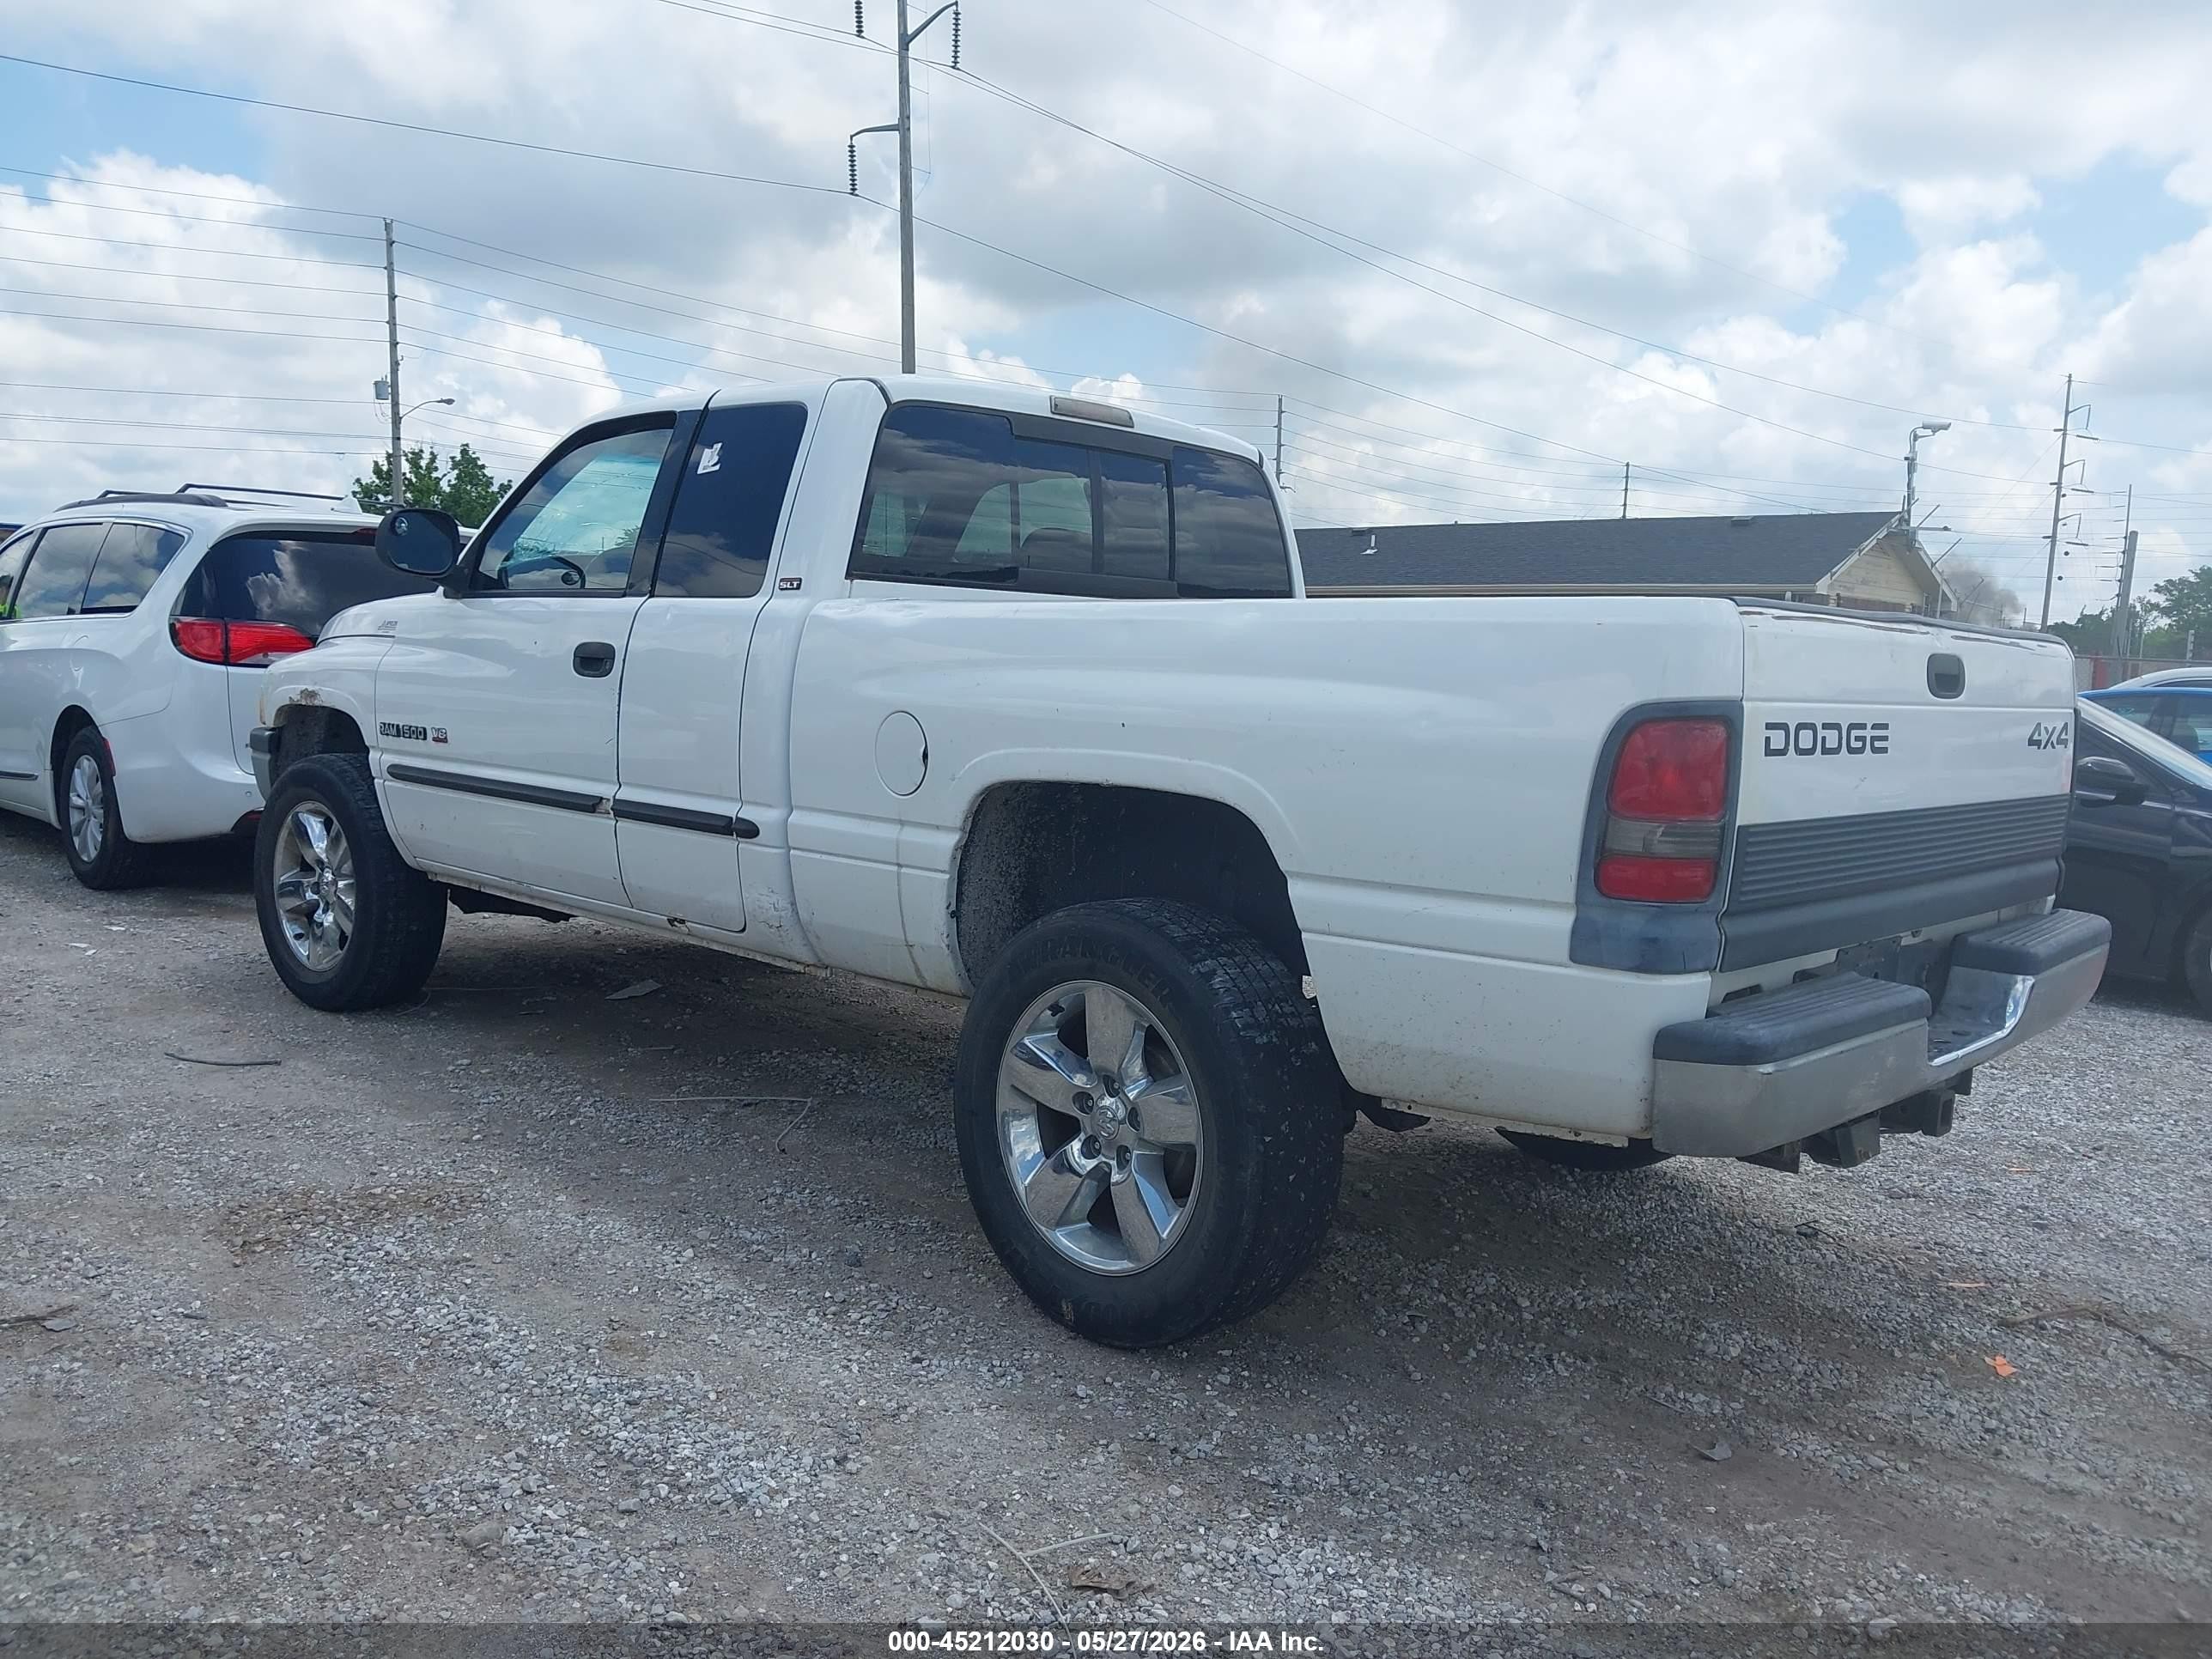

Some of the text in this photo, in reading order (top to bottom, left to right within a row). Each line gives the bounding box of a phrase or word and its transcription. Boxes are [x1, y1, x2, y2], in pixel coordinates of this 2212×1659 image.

[779, 580, 800, 589] SLT
[380, 722, 426, 739] RAM 1500
[430, 727, 447, 739] V8
[2027, 722, 2069, 750] 4x4
[1764, 722, 1890, 757] DODGE
